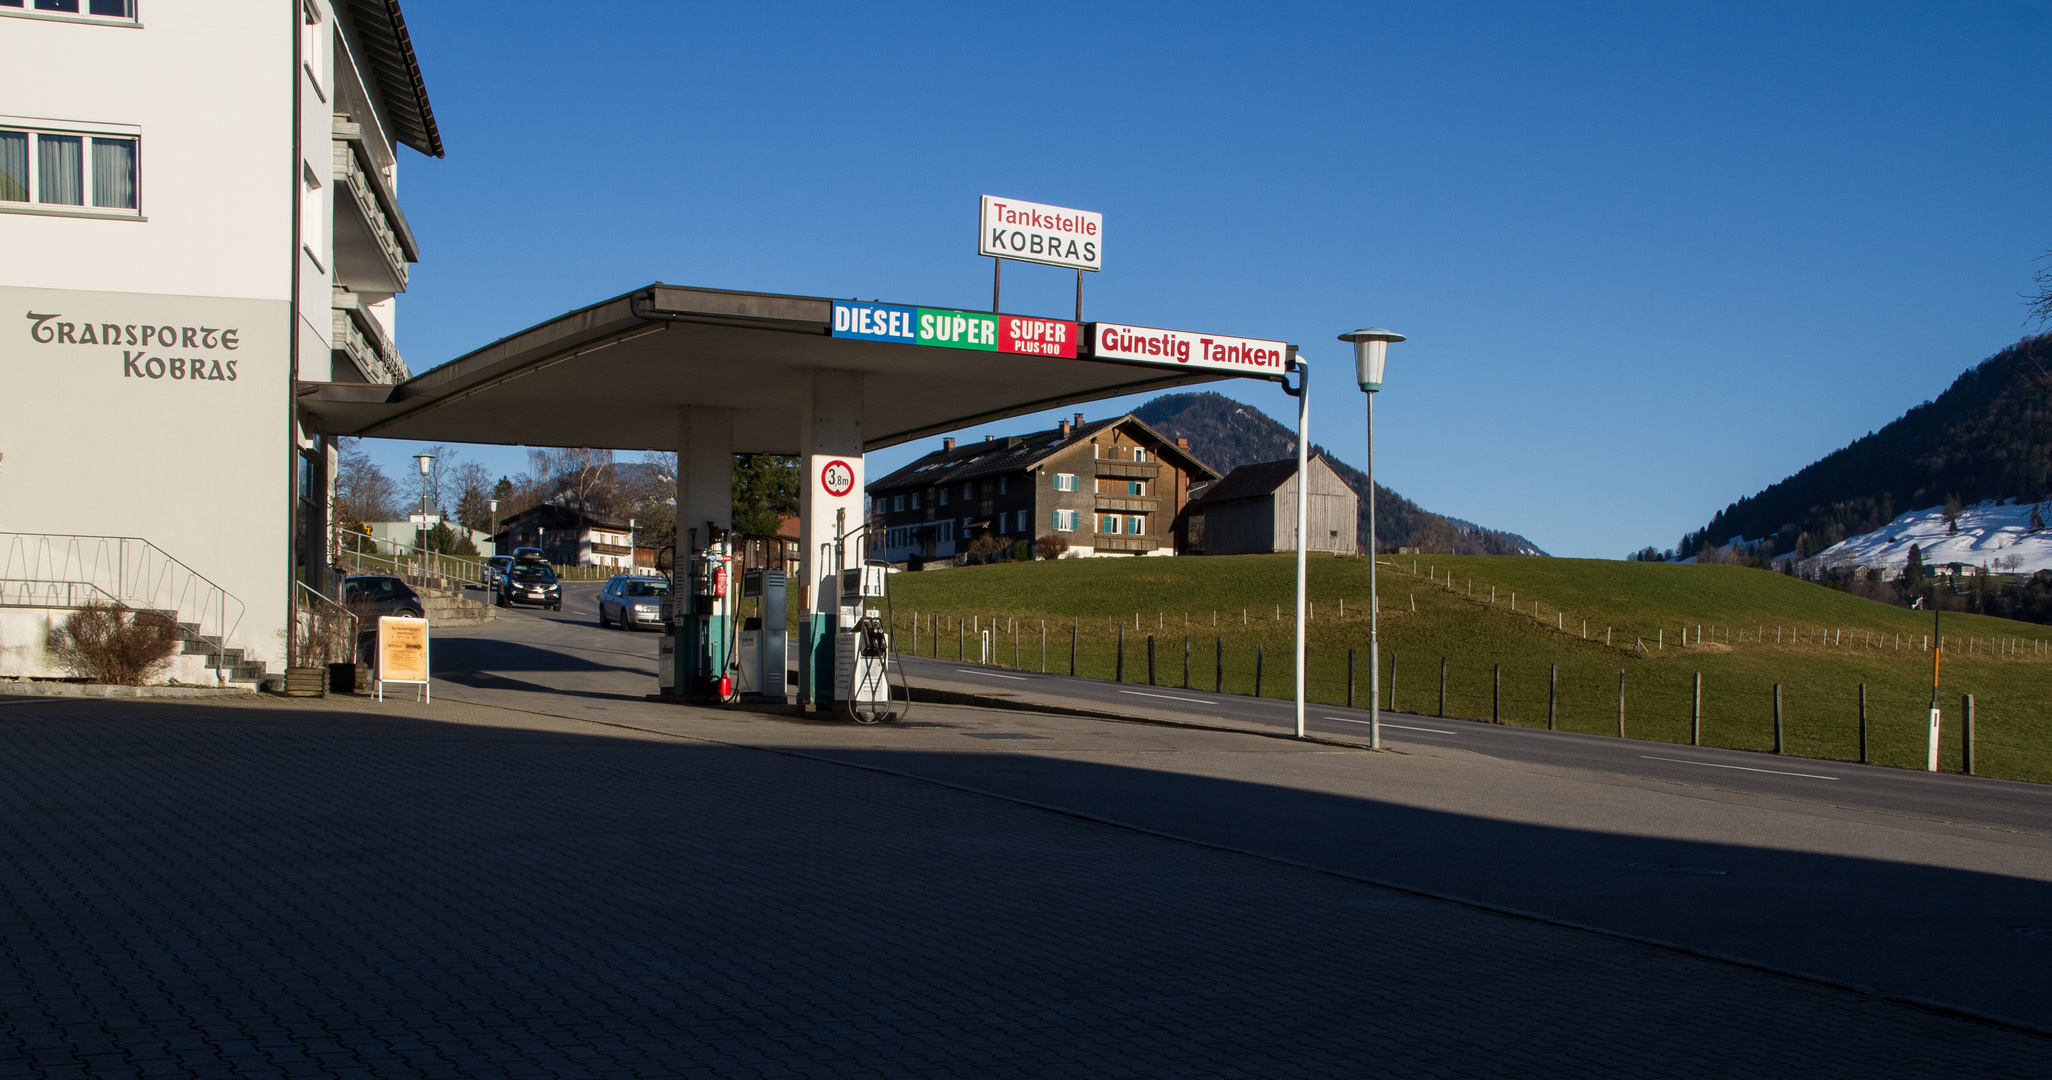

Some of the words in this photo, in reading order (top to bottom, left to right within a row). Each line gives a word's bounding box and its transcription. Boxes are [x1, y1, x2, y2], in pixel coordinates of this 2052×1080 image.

[993, 202, 1097, 237] Tankstelle
[992, 228, 1096, 262] KOBRAS
[835, 305, 915, 338] DIESEL
[920, 313, 995, 345] SUPER
[1009, 318, 1066, 343] SUPER
[1014, 339, 1040, 354] PLUS
[1041, 342, 1060, 355] 100
[1101, 326, 1190, 364] Günstig
[1199, 337, 1280, 369] Tanken
